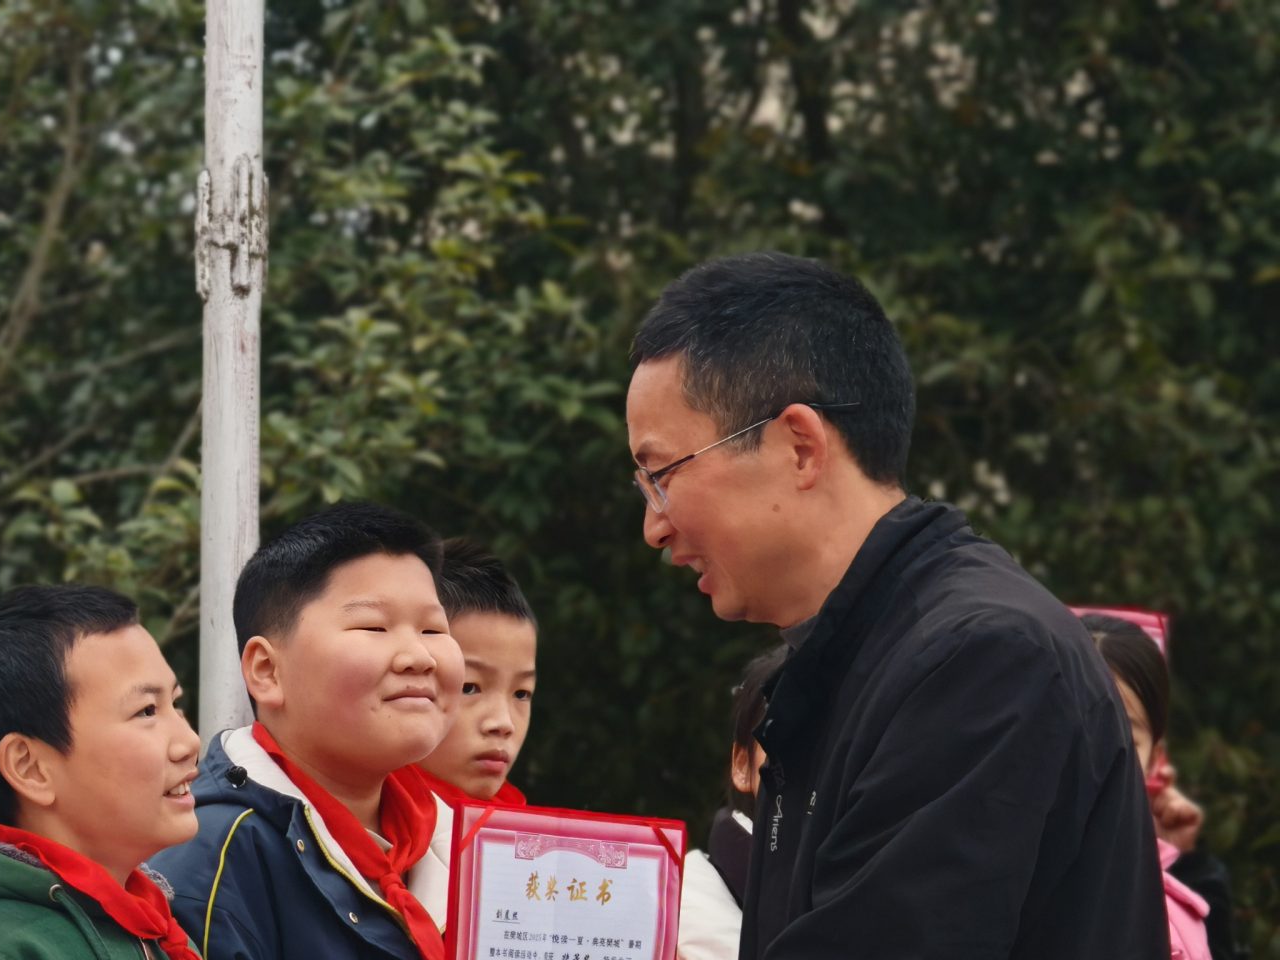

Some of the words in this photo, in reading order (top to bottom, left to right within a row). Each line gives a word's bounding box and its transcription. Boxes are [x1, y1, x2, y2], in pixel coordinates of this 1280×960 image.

[770, 794, 783, 852] Ariens
[525, 870, 613, 906] 获奖证书
